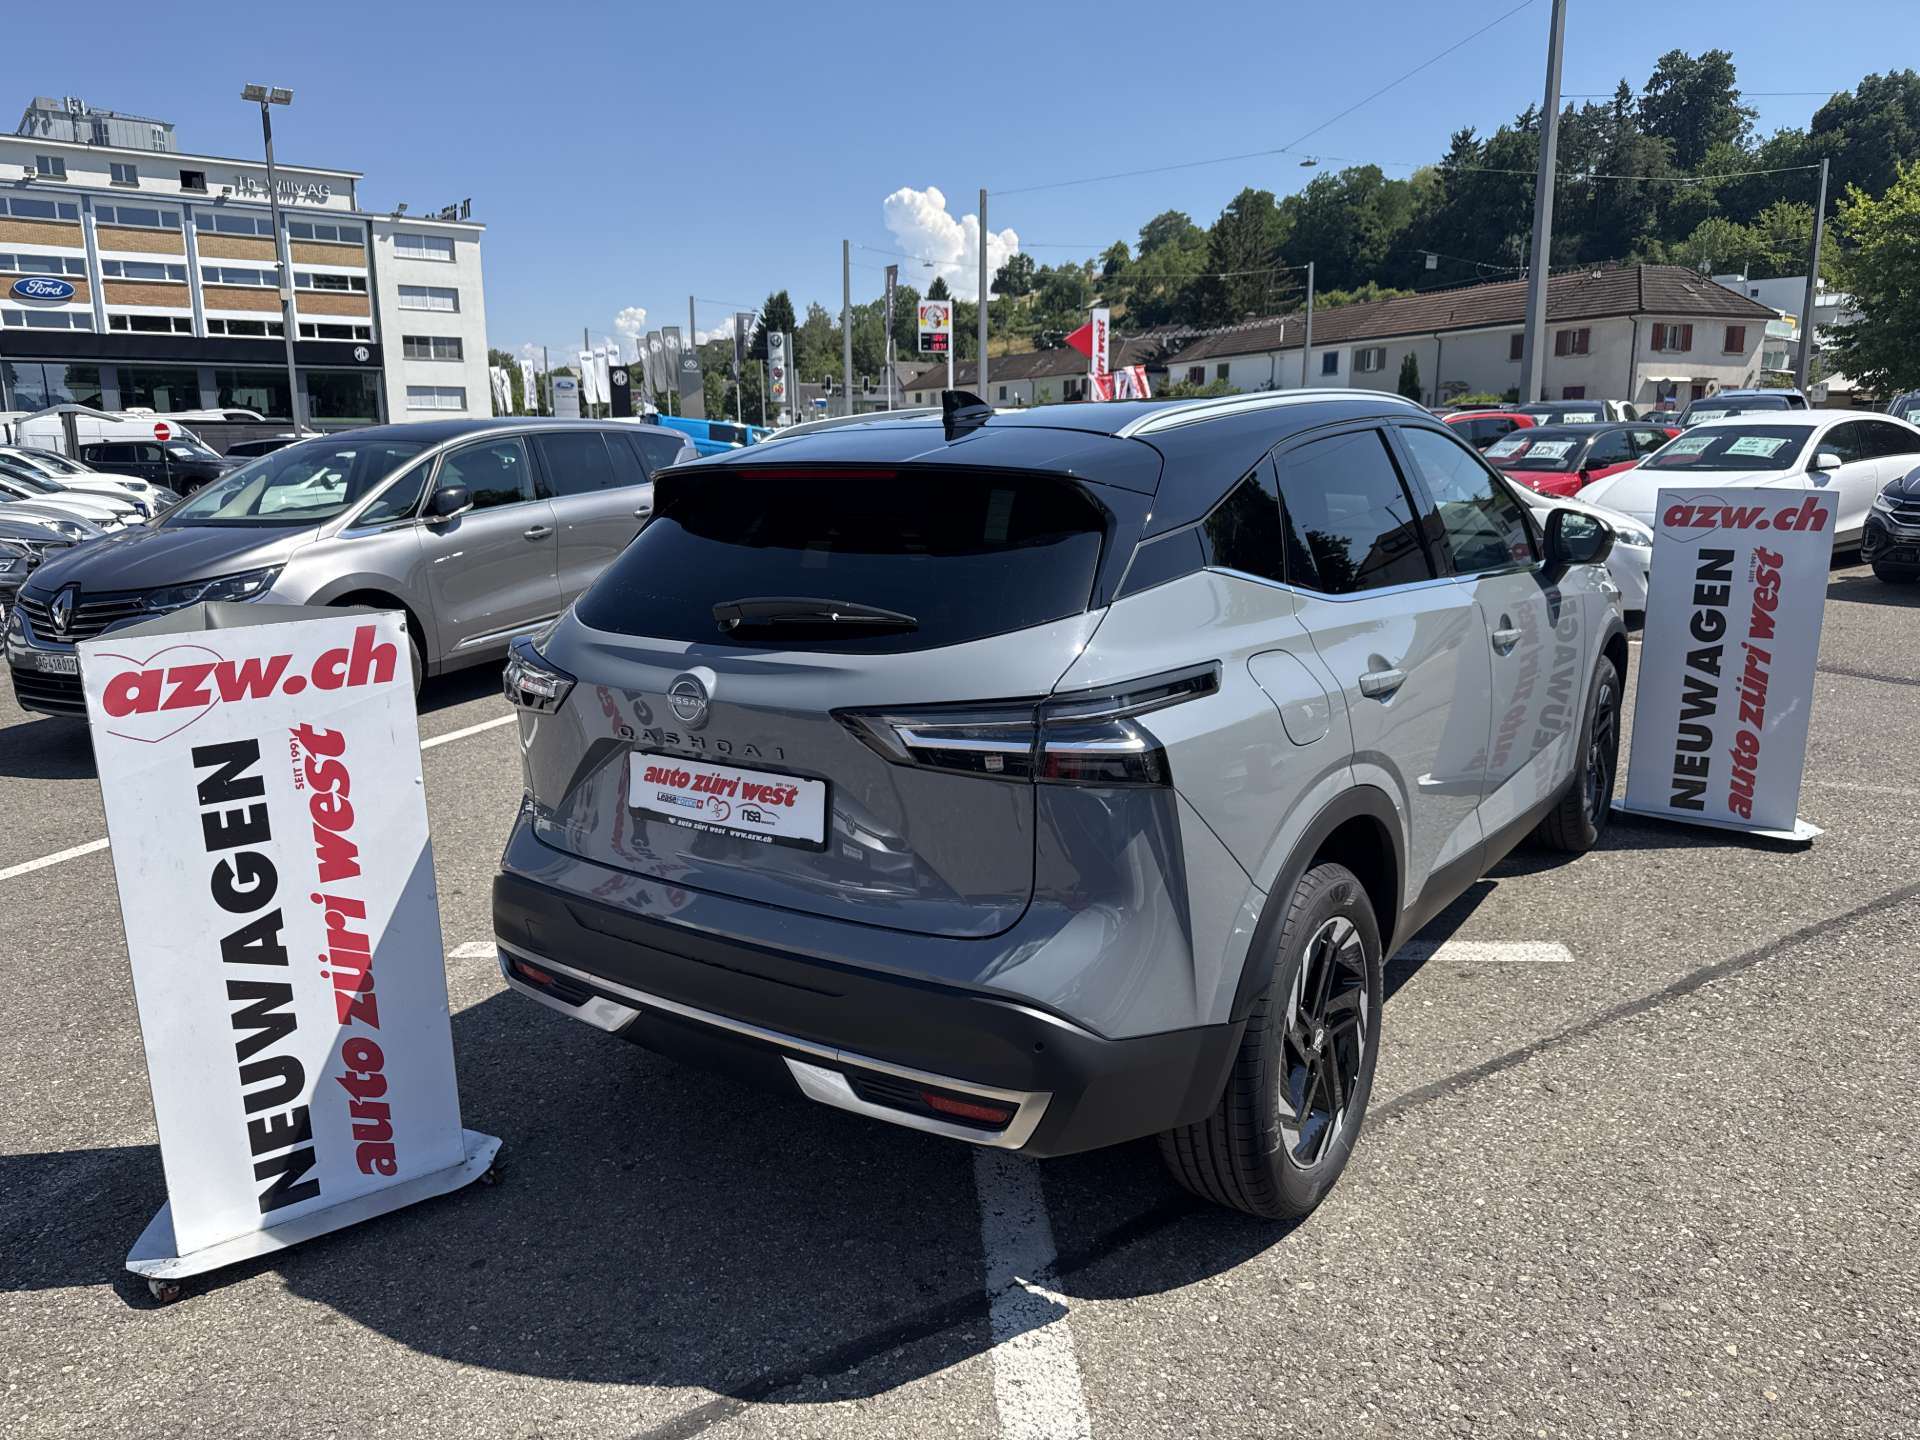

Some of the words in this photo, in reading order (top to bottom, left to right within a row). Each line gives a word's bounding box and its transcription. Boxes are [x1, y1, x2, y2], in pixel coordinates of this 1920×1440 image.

[307, 183, 331, 197] AG
[26, 280, 62, 295] Ford
[354, 346, 369, 361] MG
[613, 370, 628, 386] MG
[1663, 497, 1829, 532] azw.ch
[1748, 546, 1784, 640] west
[102, 625, 398, 717] azw.ch
[1669, 548, 1735, 811] NEUWAGEN
[1735, 641, 1772, 731] züri
[666, 693, 708, 708] NISSAN
[289, 737, 302, 764] 1991
[620, 724, 785, 760] QASHQAI
[293, 767, 305, 790] SEIT
[643, 765, 691, 790] auto
[691, 773, 741, 798] züri
[741, 782, 799, 808] west
[1727, 730, 1760, 820] auto
[289, 722, 362, 883] west
[742, 809, 761, 823] nsa
[677, 820, 693, 828] auto
[693, 822, 708, 831] züri
[709, 826, 726, 834] west
[191, 738, 320, 1214] NEUWAGEN
[310, 892, 380, 1030] züri
[335, 1036, 398, 1177] auto
